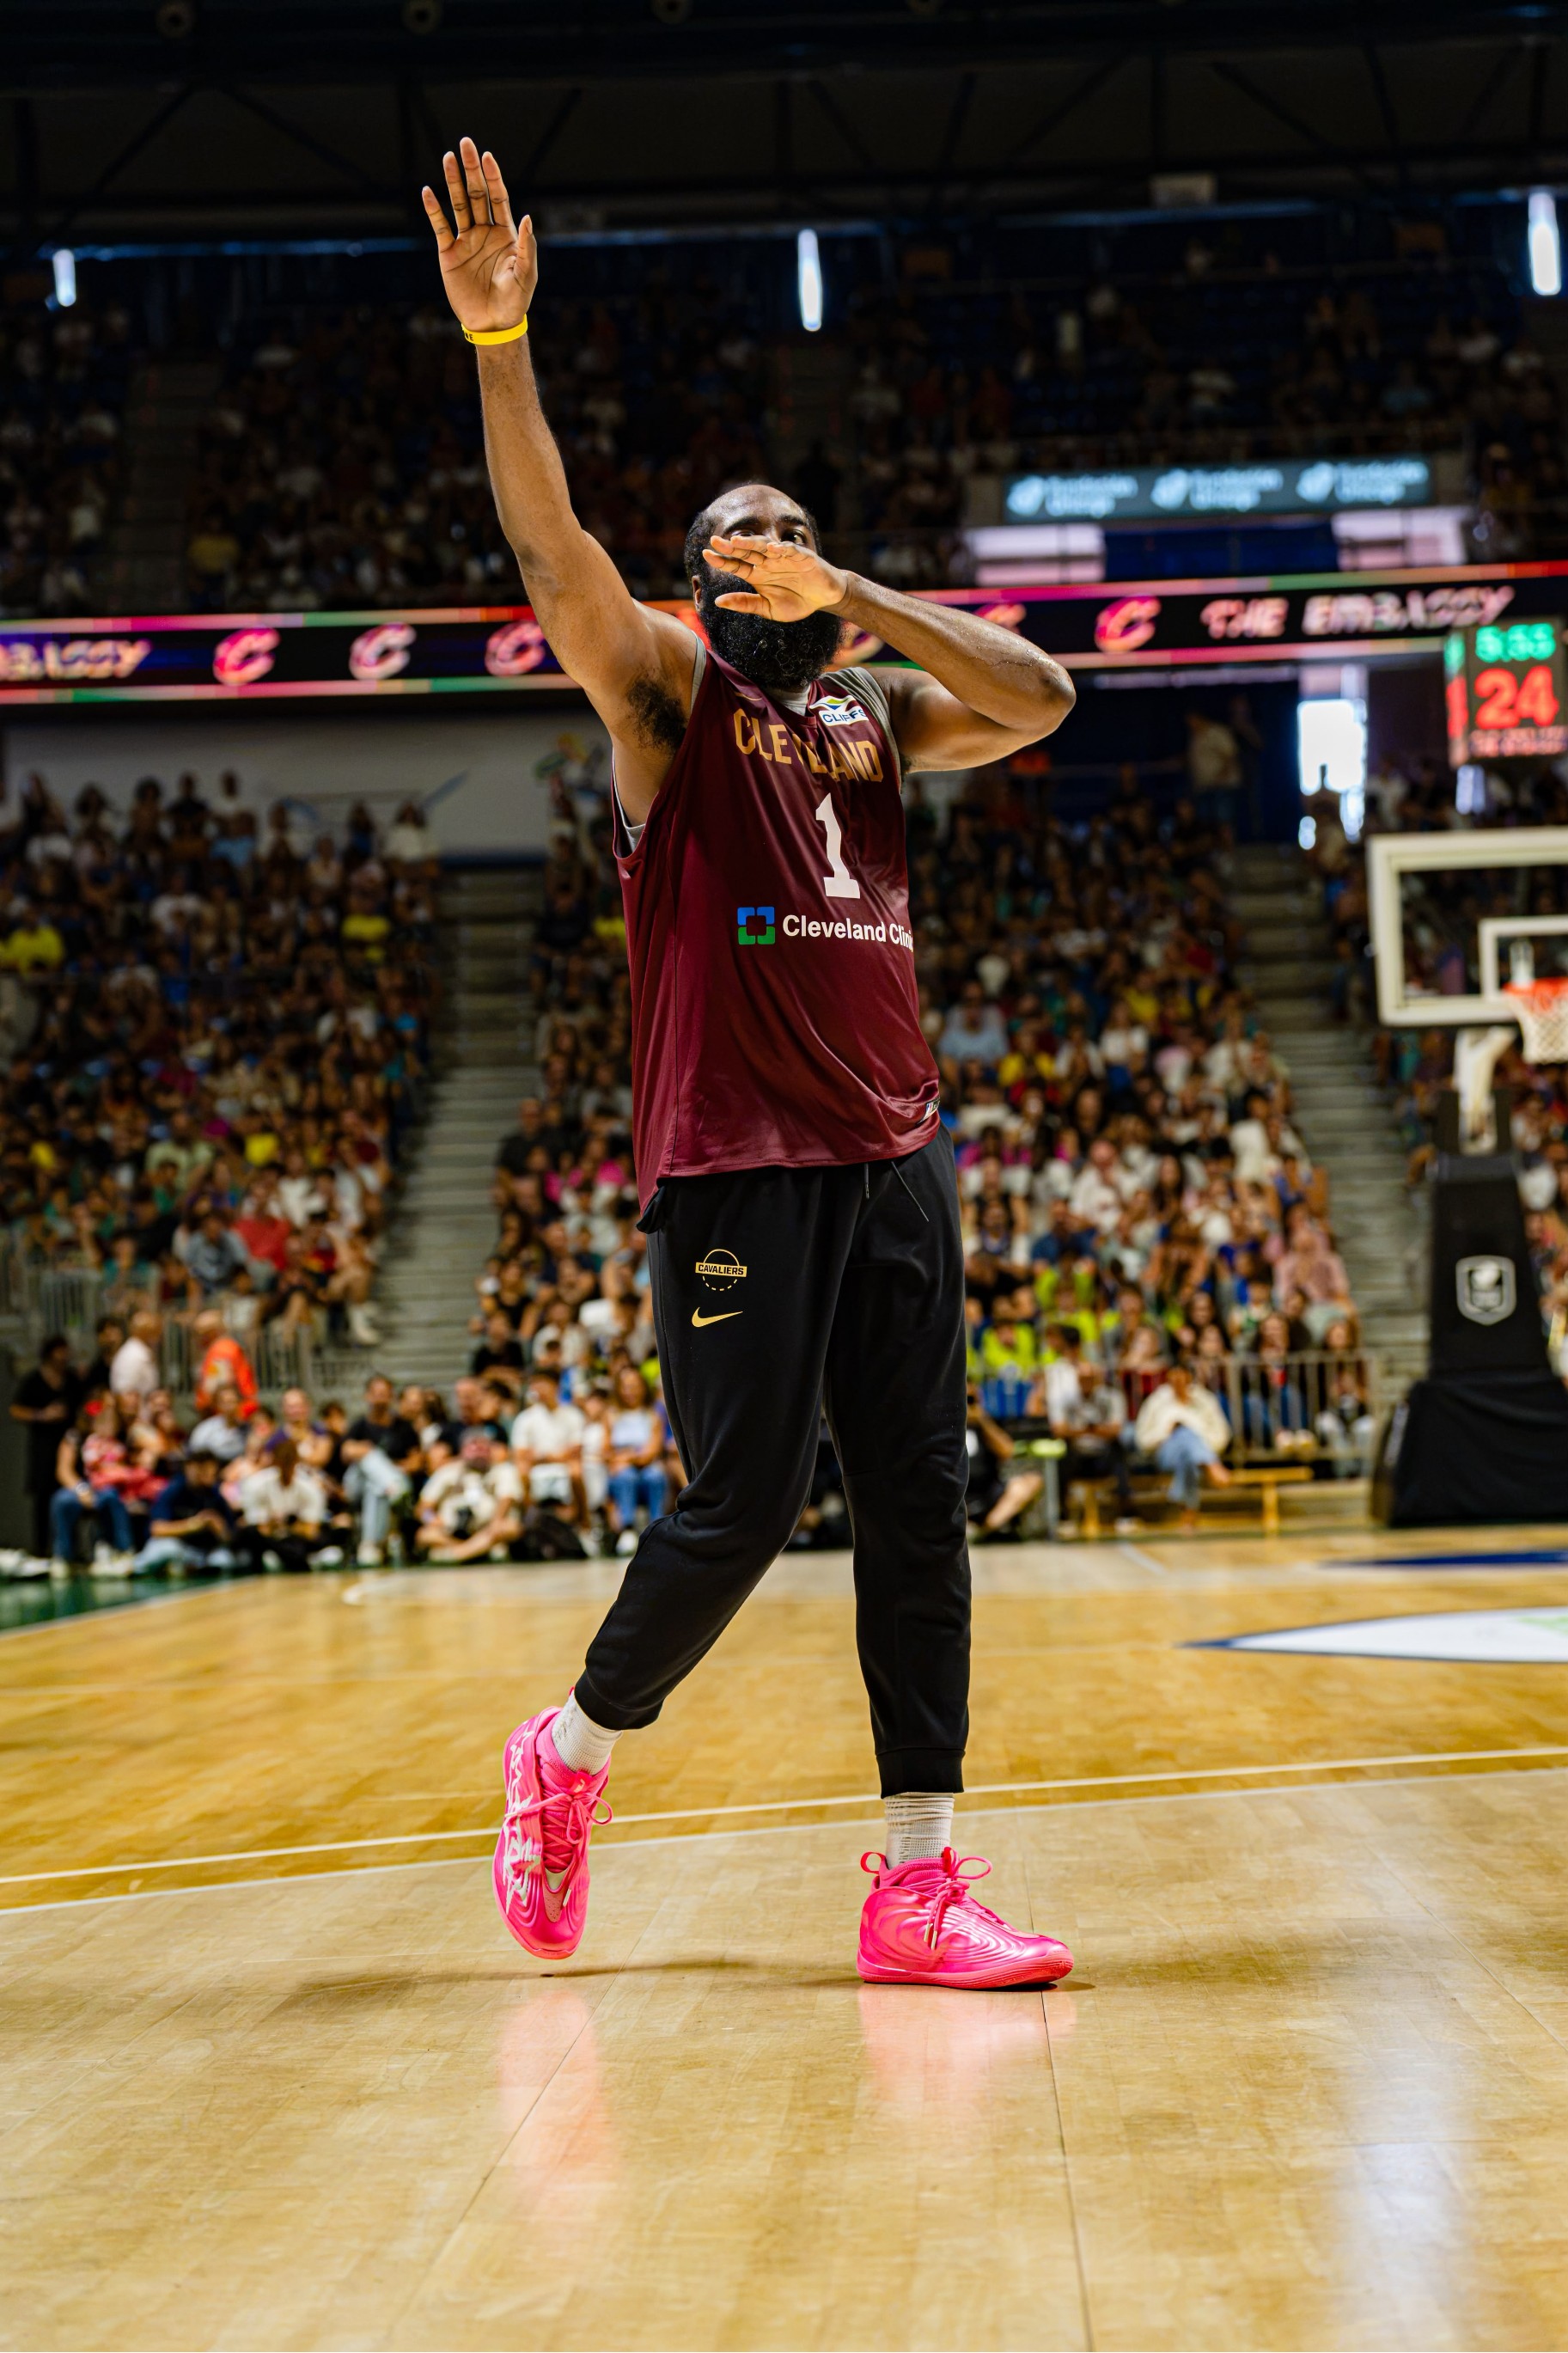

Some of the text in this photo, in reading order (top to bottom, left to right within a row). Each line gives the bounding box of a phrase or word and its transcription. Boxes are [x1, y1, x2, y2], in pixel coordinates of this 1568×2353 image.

[822, 709, 867, 723] CLIFFS
[1474, 665, 1559, 730] 24
[733, 708, 884, 783] CLELAND
[815, 792, 861, 899] 1
[783, 914, 887, 943] Cleveland
[699, 1264, 744, 1275] CAVALIERS
